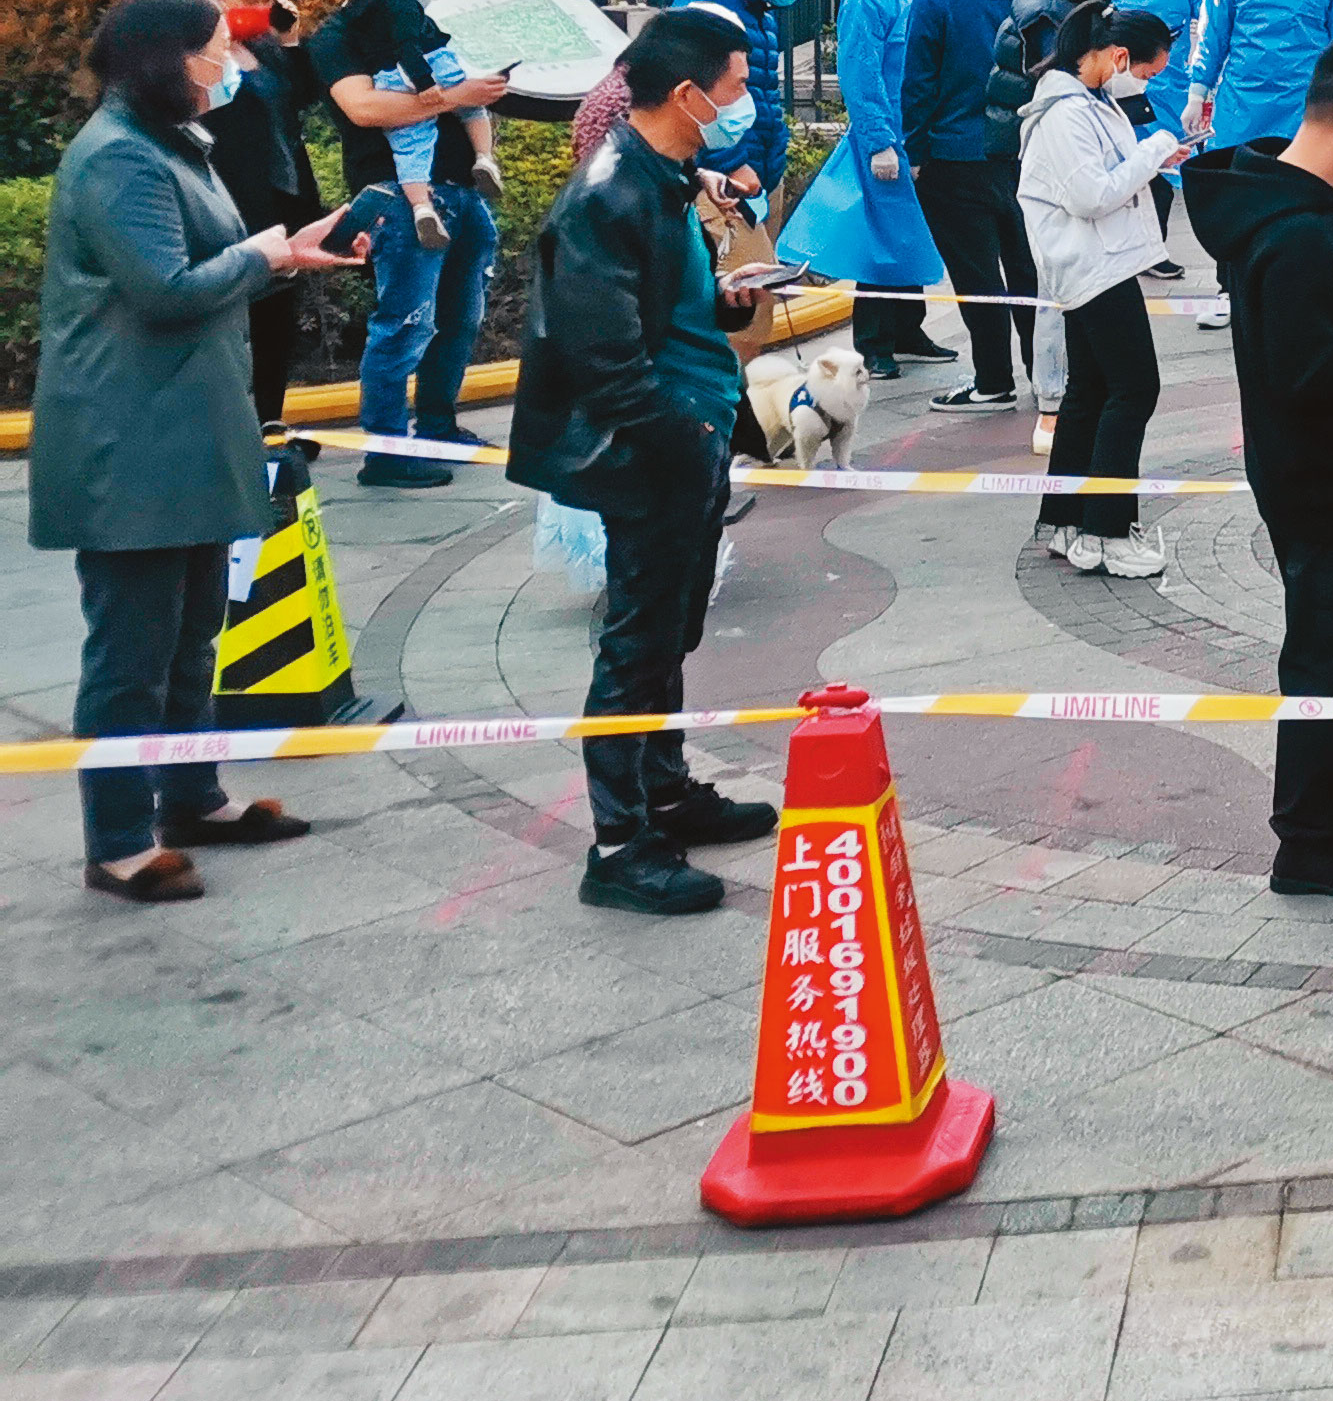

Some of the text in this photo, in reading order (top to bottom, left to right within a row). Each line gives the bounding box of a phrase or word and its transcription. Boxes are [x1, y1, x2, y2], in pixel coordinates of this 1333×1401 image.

[982, 476, 1063, 492] LIMITLINE
[1050, 696, 1161, 719] LIMITLINE
[414, 721, 537, 746] LIMITLINE
[781, 833, 828, 1106] 上门服务热线
[824, 829, 868, 1106] 4001691900
